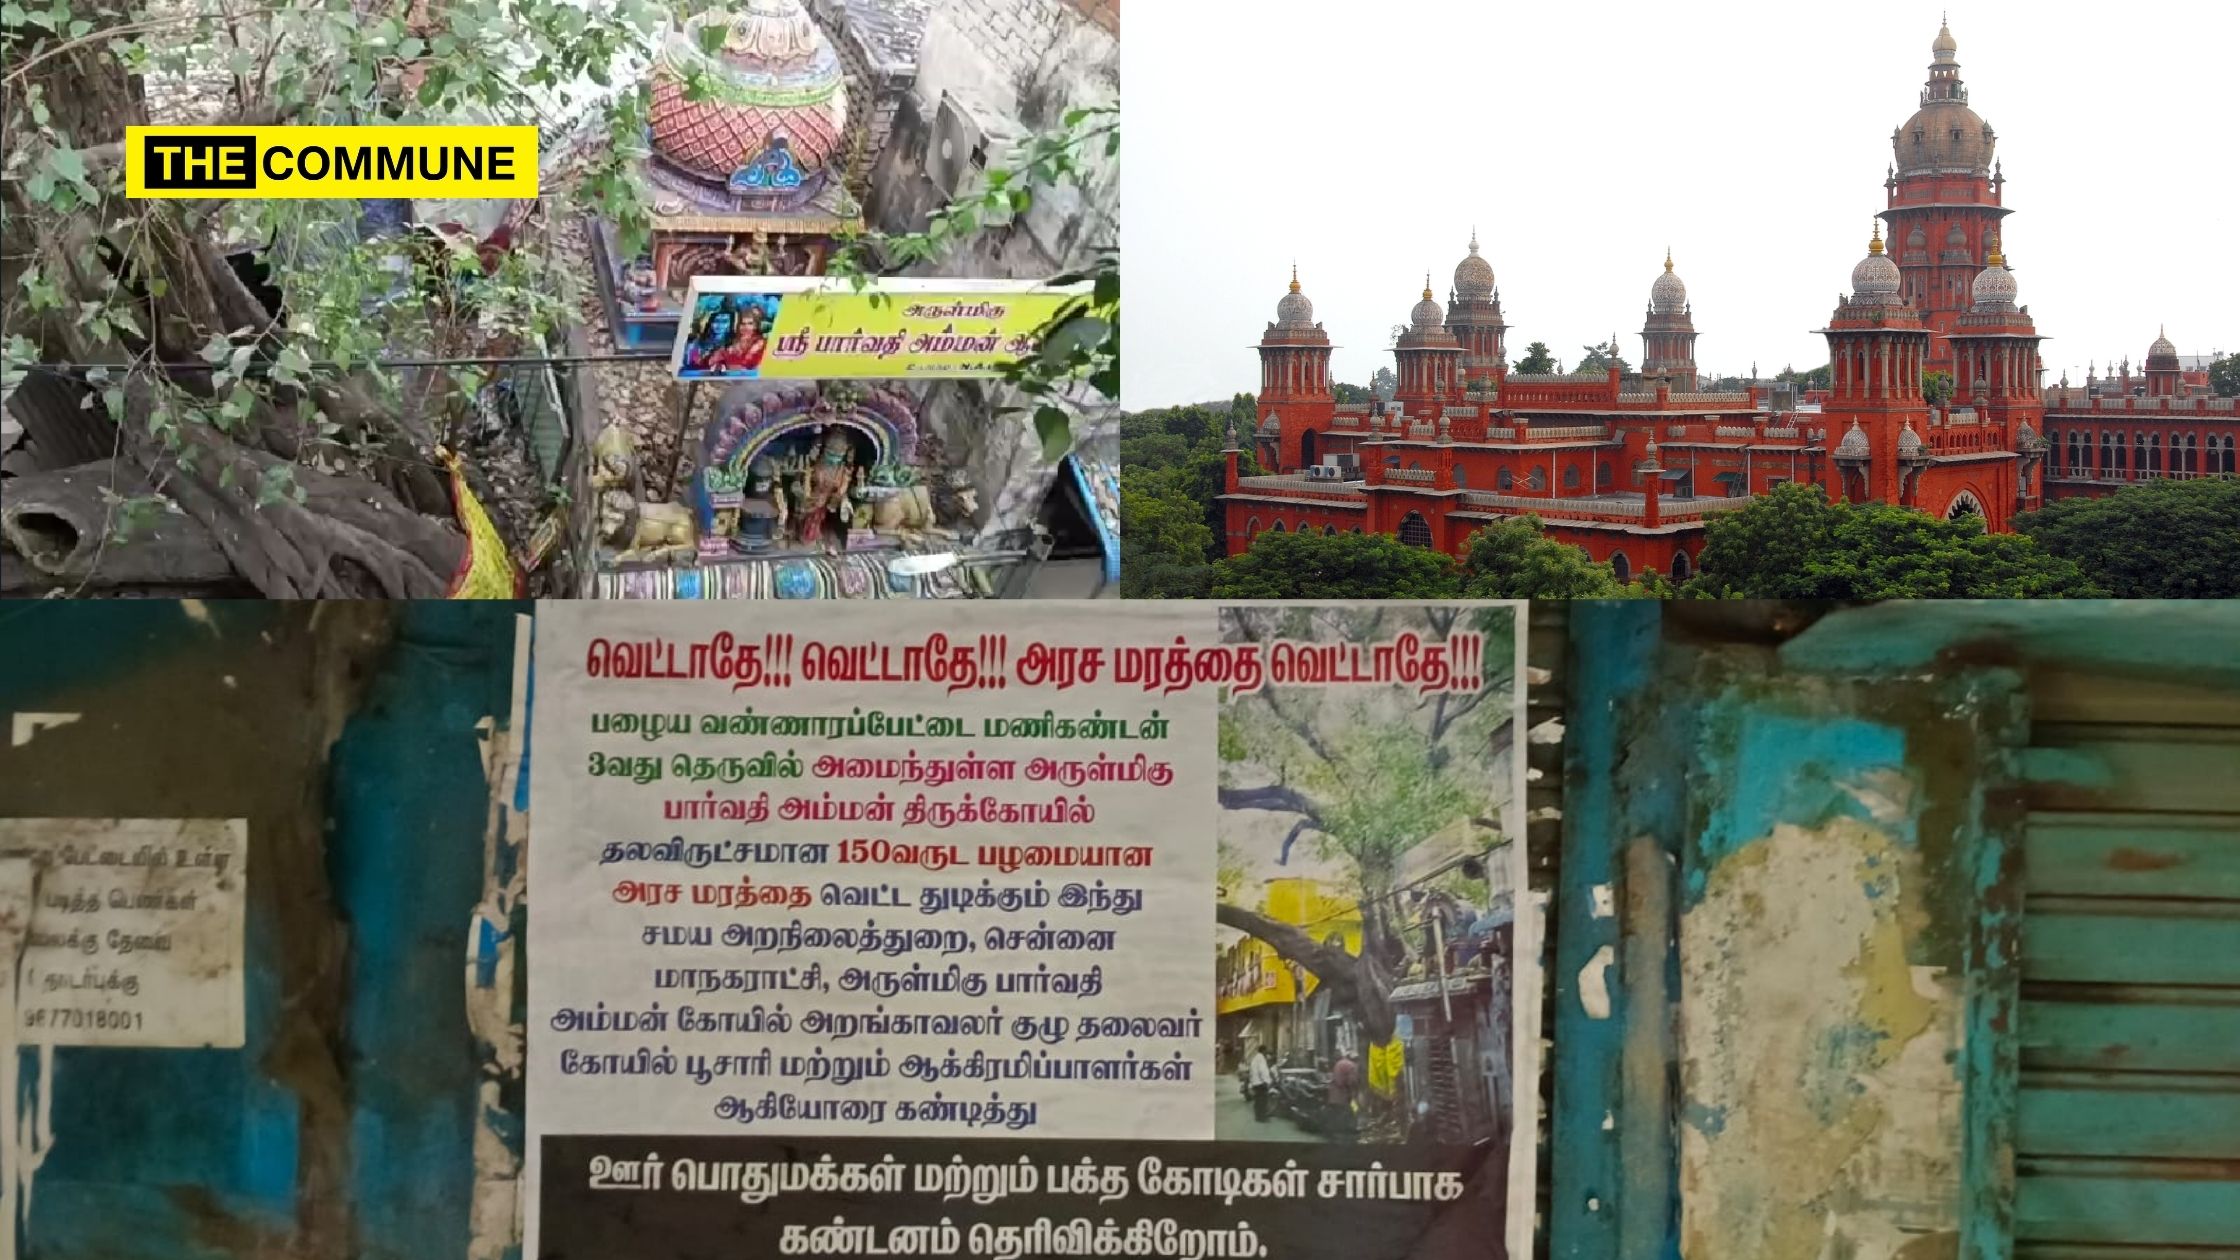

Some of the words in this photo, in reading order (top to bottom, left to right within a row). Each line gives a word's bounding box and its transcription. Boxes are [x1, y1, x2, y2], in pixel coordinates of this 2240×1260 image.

[902, 301, 1005, 319] அருள்மிகு
[815, 327, 906, 359] பார்வதி
[910, 322, 1001, 354] அம்மன்
[587, 632, 793, 693] வெட்டாதே!!!
[802, 632, 1006, 697] வெட்டாதே!!!
[1016, 642, 1105, 691] அரச
[1114, 636, 1262, 697] மரத்தை
[1271, 632, 1480, 695] வெட்டாதே!!!
[591, 712, 691, 741] பழைய
[700, 706, 975, 740] வண்ணாரப்பேட்டை
[984, 709, 1170, 740] மணிகண்டன்
[588, 752, 662, 785] 3வது
[671, 750, 803, 784] தெருவில்
[812, 750, 1015, 787] அமைந்துள்ள
[1025, 752, 1174, 787] அருள்மிகு
[664, 790, 768, 825] பார்வதி
[778, 792, 894, 822] அம்மன்
[901, 793, 1095, 828] திருக்கோயில்
[599, 835, 829, 868] தலவிருட்சமான
[837, 839, 969, 871] 150வருட
[978, 846, 1153, 873] பழமையான
[612, 880, 682, 906] அரச
[691, 875, 812, 909] மரத்தை
[820, 883, 911, 908] வெட்ட
[919, 878, 1050, 914] துடிக்கும்
[1058, 878, 1143, 915] இந்து
[642, 925, 712, 946] சமய
[721, 919, 975, 957] அறநிலைத்துறை,
[985, 921, 1116, 951] சென்னை
[655, 962, 830, 995] மாநகராட்சி,
[838, 963, 987, 998] அருள்மிகு
[996, 963, 1103, 1000] பார்வதி
[551, 1002, 668, 1032] அம்மன்
[677, 1003, 793, 1034] கோயில்
[801, 1004, 1004, 1041] அறங்காவலர்
[1012, 1015, 1070, 1044] குழு
[1076, 1008, 1203, 1042] தலைவர்
[561, 1046, 678, 1075] கோயில்
[686, 1047, 772, 1085] பூசாரி
[780, 1047, 891, 1085] மற்றும்
[899, 1048, 1192, 1082] ஆக்கிரமிப்பாளர்கள்
[714, 1091, 887, 1124] ஆகியோரை
[895, 1091, 1038, 1130] கண்டித்து
[589, 1152, 664, 1189] ஊர்
[672, 1154, 906, 1203] பொதுமக்கள்
[914, 1154, 1038, 1203] மற்றும்
[1047, 1156, 1129, 1204] பக்த
[1138, 1157, 1309, 1205] கோடிகள்
[1317, 1160, 1464, 1200] சார்பாக
[779, 1215, 960, 1255] கண்டனம்
[968, 1217, 1268, 1260] தெரிவிக்கிறோம்.
